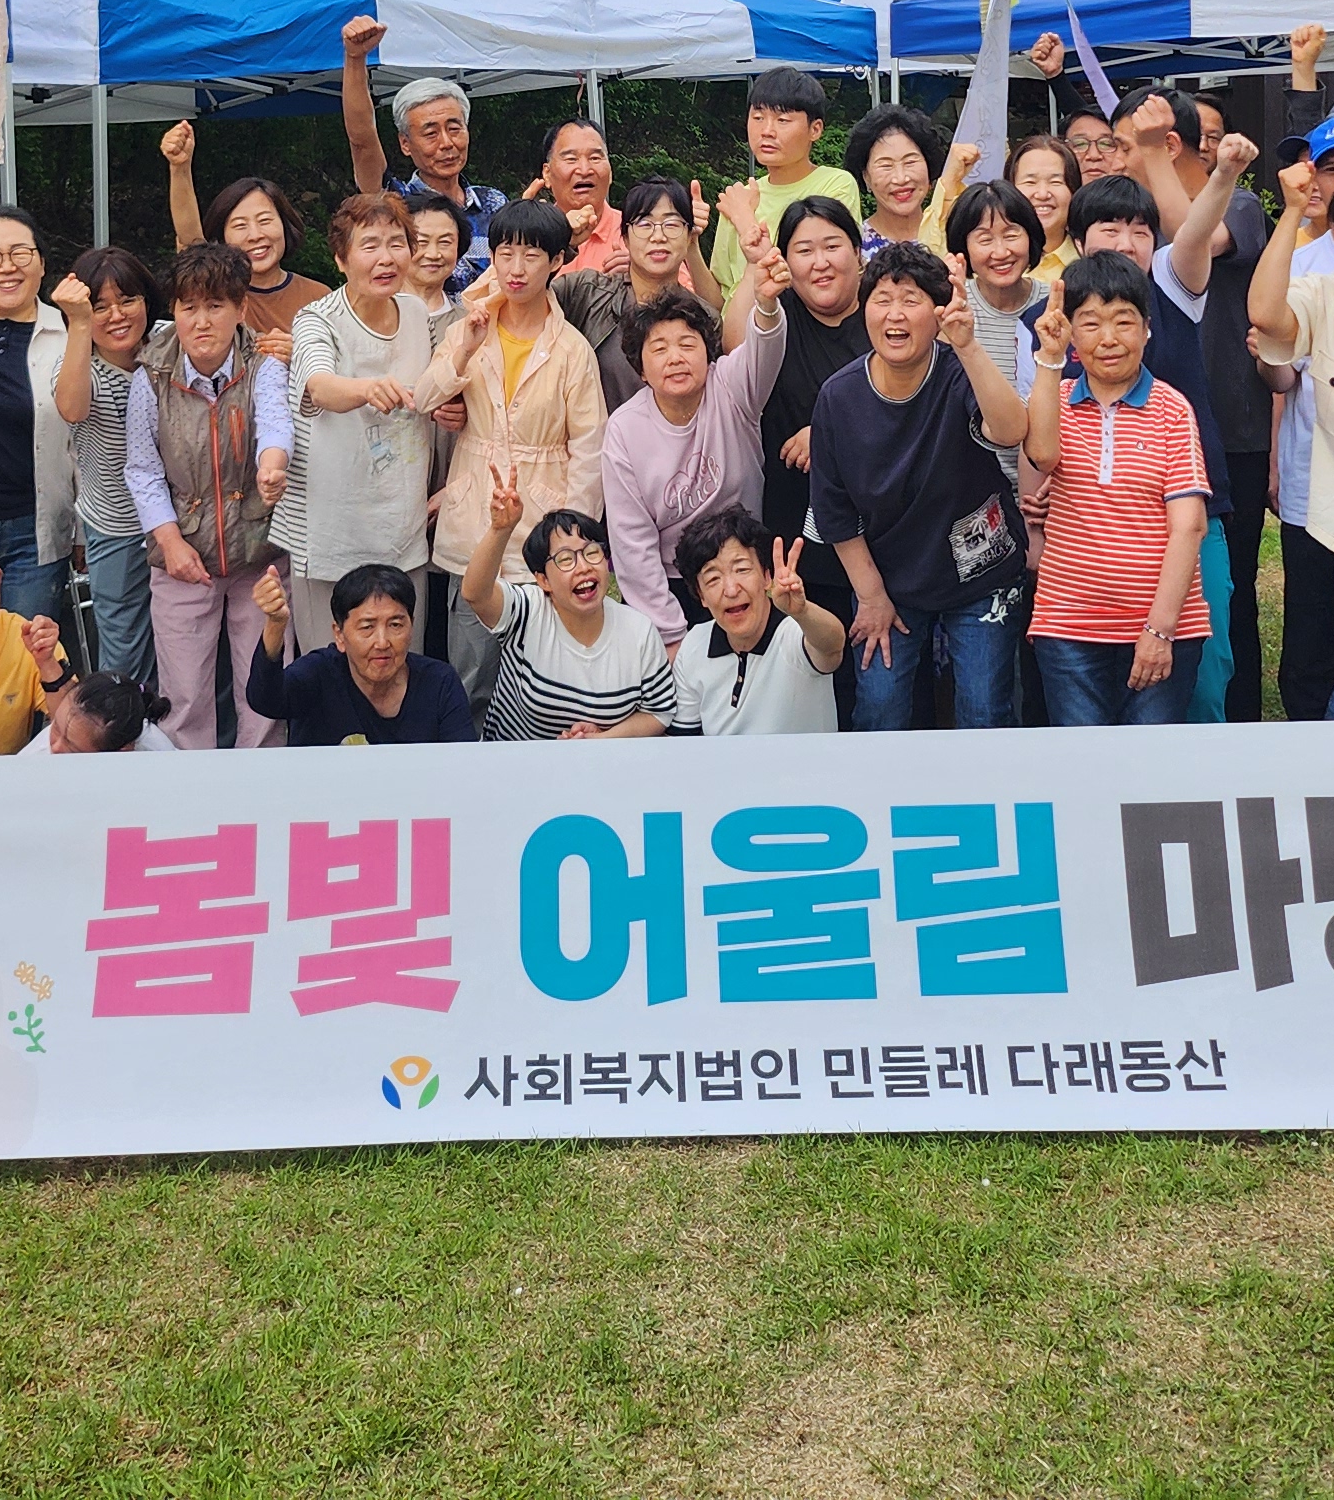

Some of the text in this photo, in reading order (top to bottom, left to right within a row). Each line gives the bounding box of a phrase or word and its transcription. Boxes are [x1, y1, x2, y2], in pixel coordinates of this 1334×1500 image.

[85, 820, 457, 1016] 봄빛
[519, 801, 1069, 1007] 어울림
[464, 1039, 1228, 1107] 사회복지법인 민들레 다래동산
